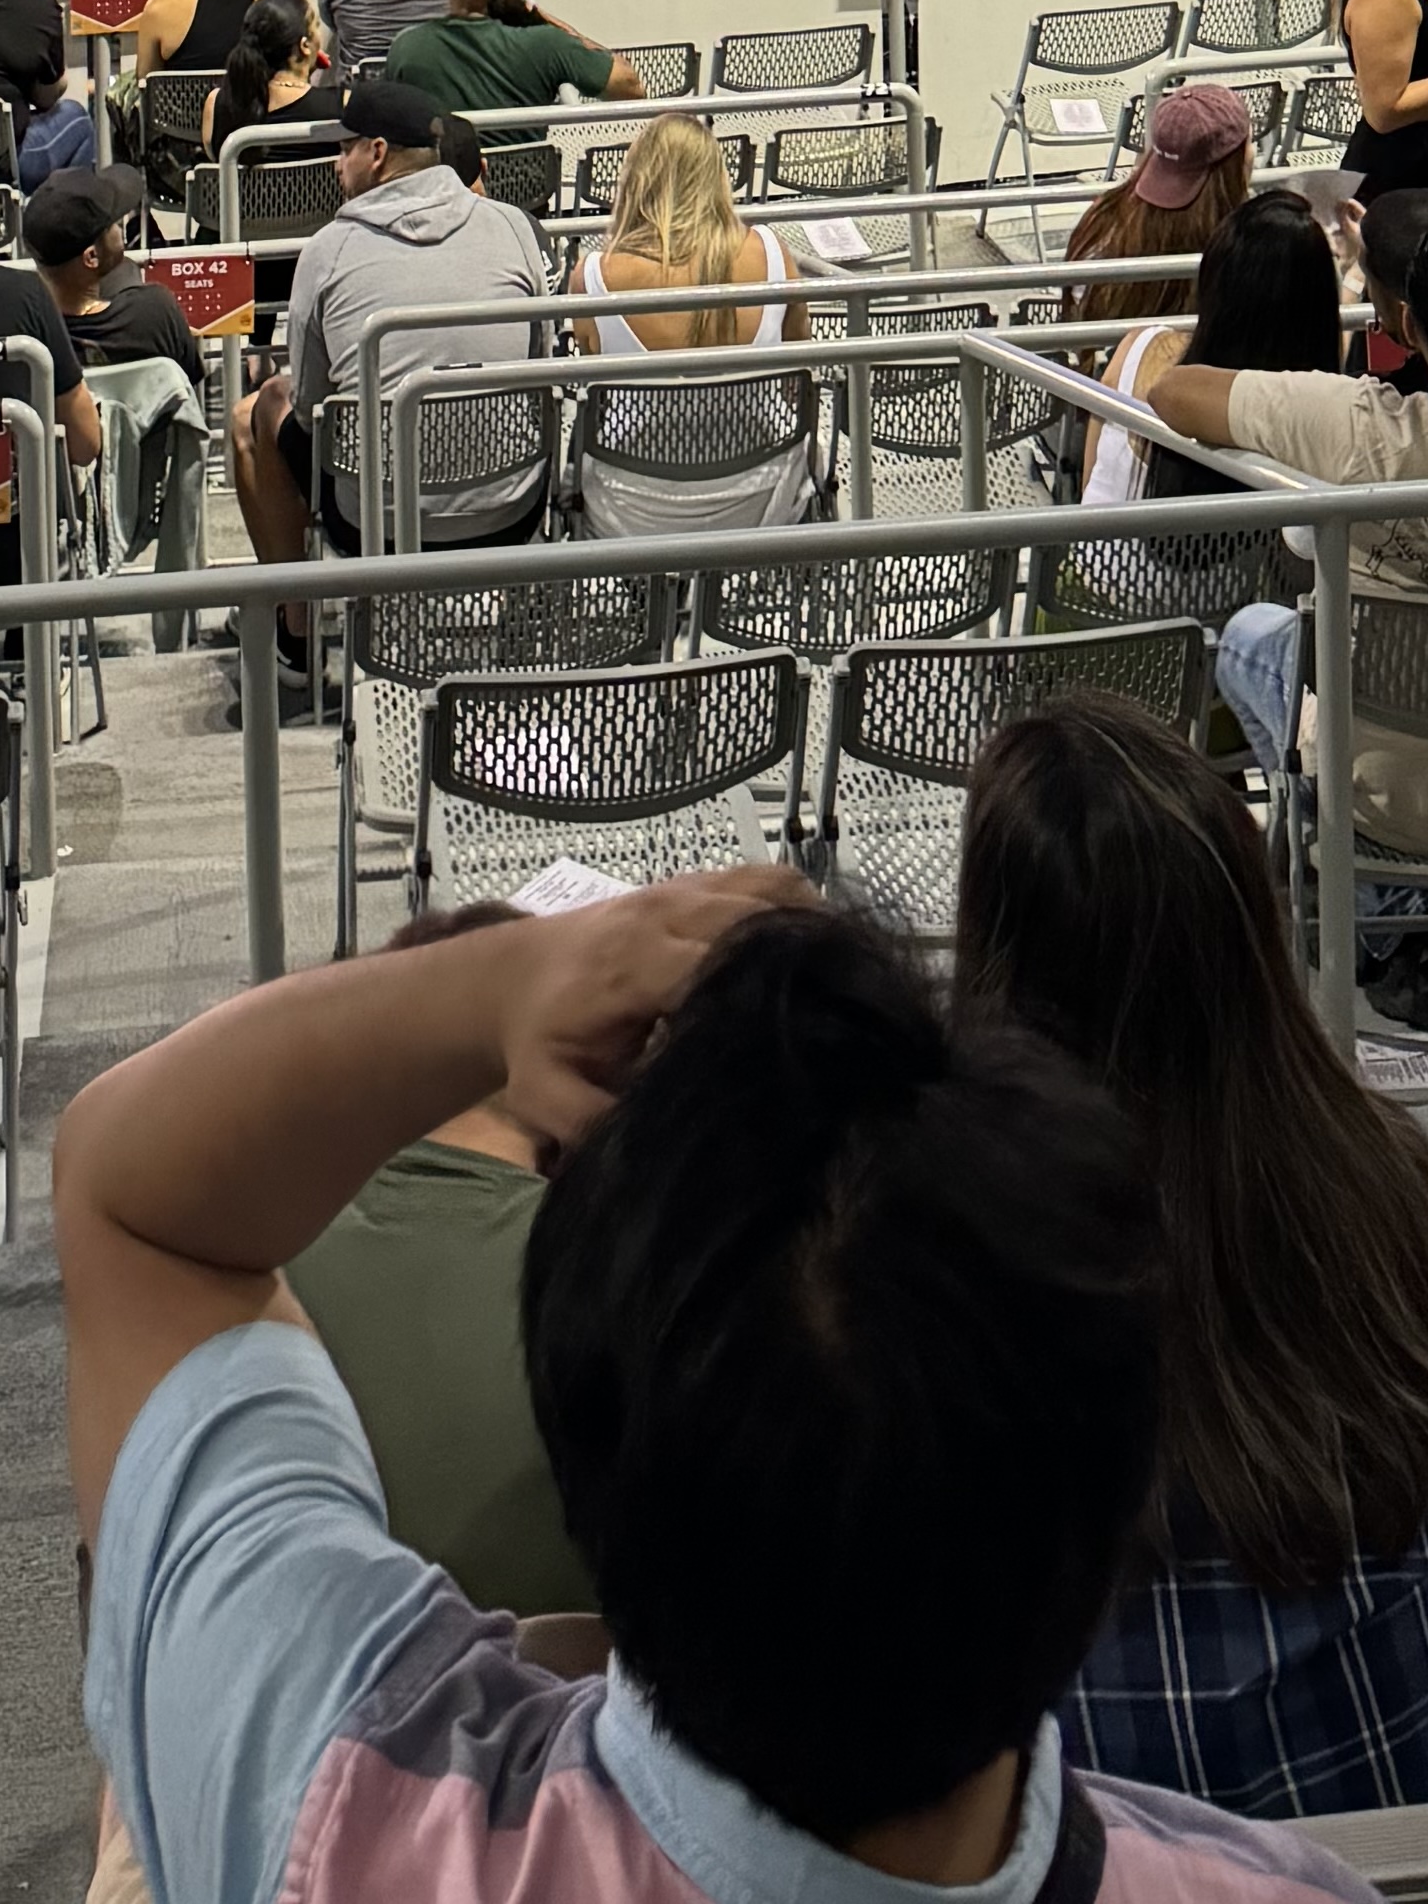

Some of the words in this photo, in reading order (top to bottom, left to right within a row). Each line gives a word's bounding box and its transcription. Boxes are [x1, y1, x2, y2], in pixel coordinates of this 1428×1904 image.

[865, 83, 889, 97] 72
[171, 261, 205, 276] BOX
[208, 260, 228, 274] 42
[184, 278, 214, 289] SEATS
